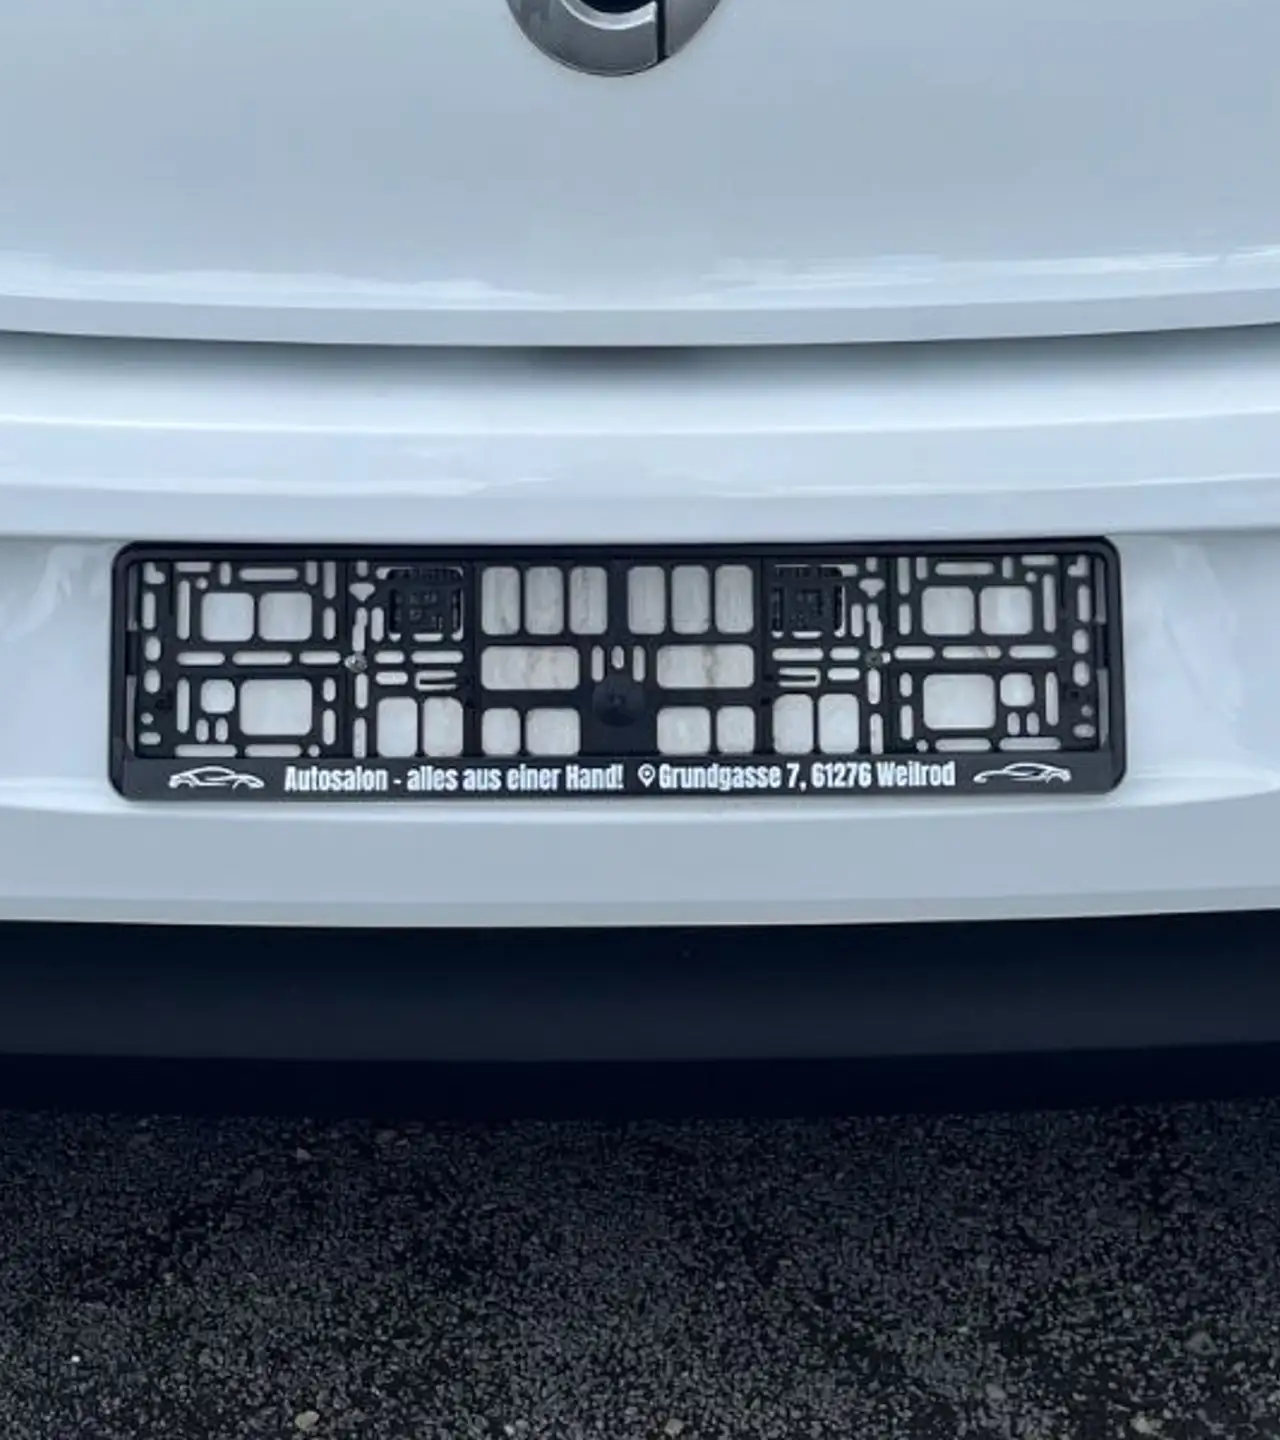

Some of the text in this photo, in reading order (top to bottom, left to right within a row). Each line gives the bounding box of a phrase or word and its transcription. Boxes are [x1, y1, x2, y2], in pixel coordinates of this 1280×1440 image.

[284, 765, 388, 791] Autosalon
[407, 765, 458, 791] alles
[462, 767, 502, 791] aus
[507, 763, 561, 790] einer
[565, 764, 624, 790] Hand!
[658, 760, 956, 792] Grundgasse 7, 61276 Weilrod
